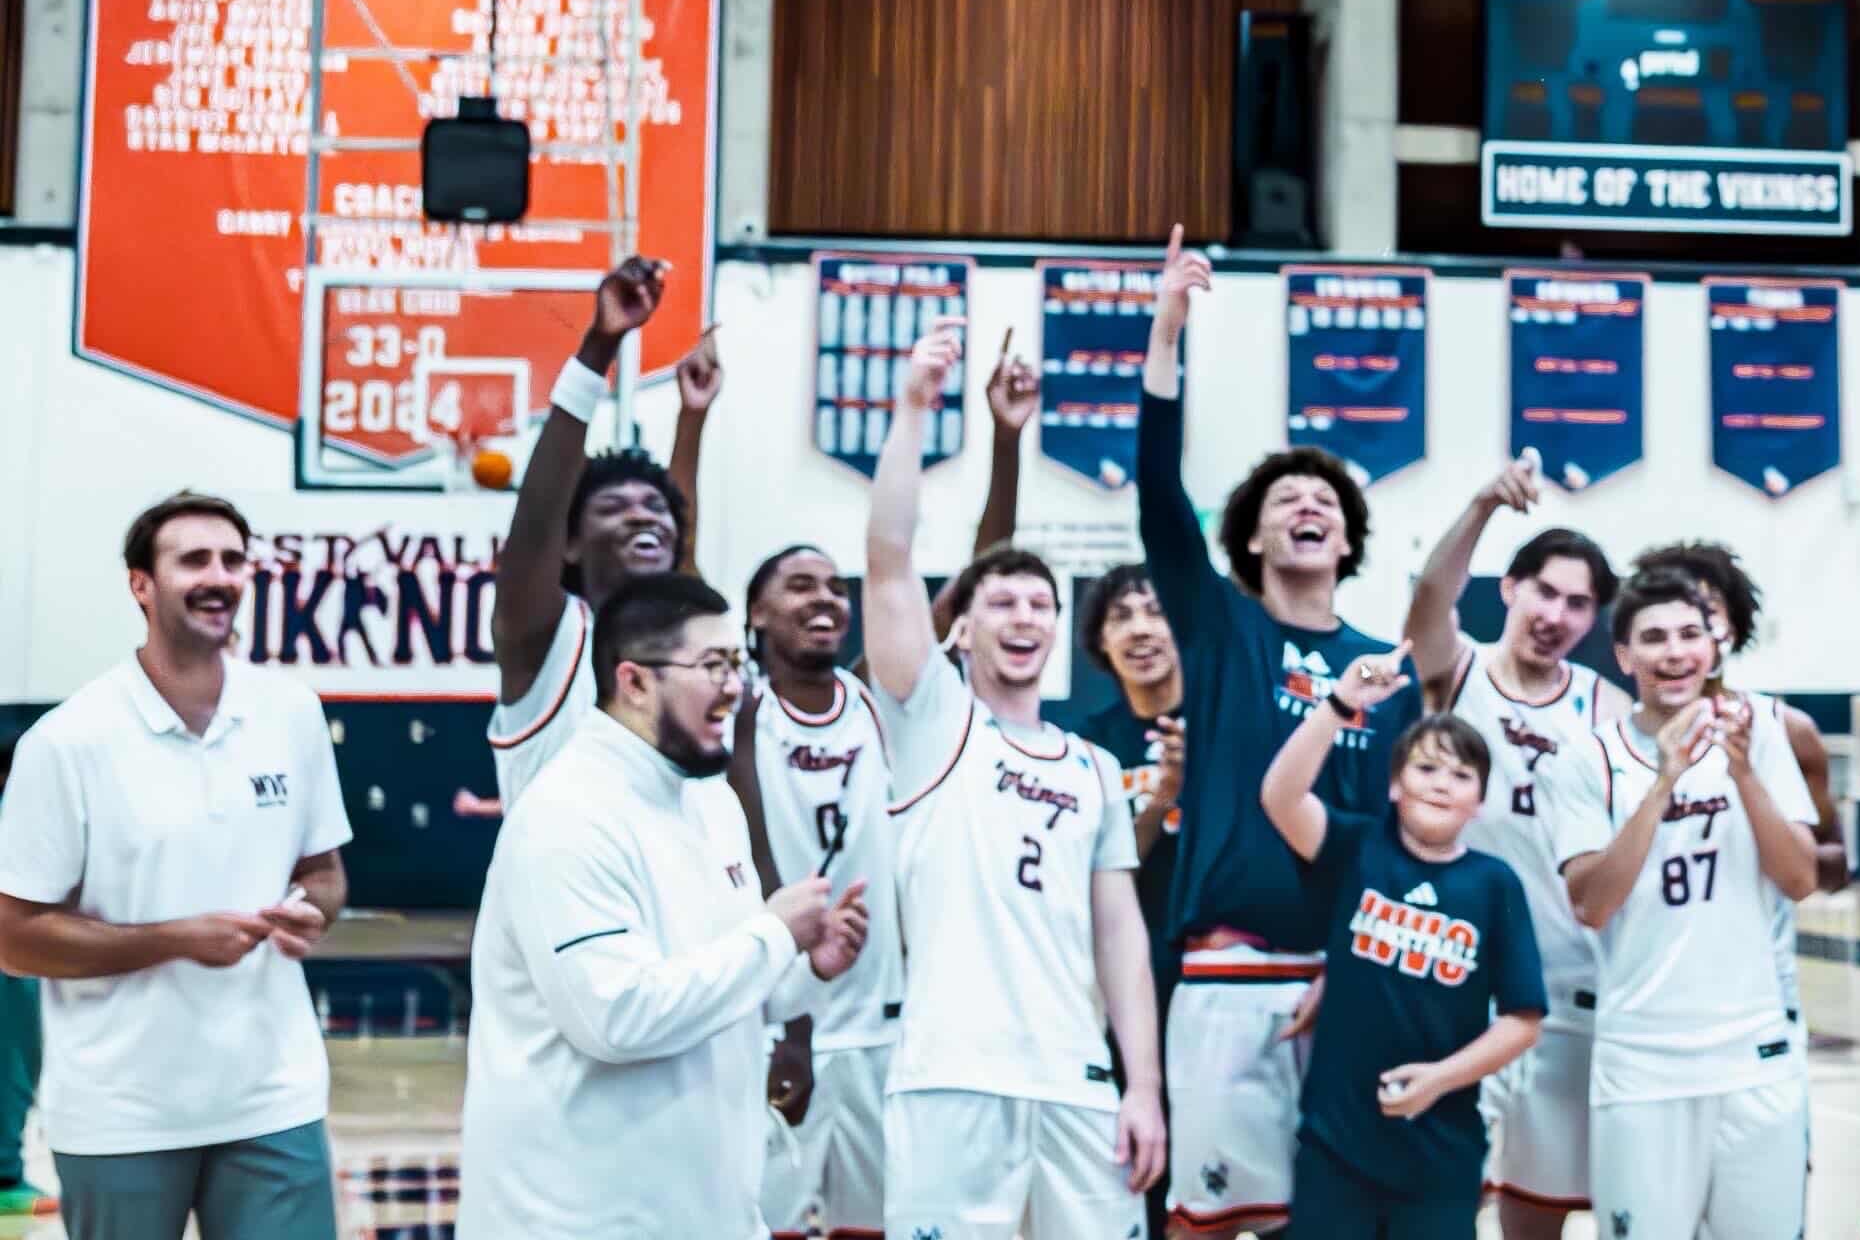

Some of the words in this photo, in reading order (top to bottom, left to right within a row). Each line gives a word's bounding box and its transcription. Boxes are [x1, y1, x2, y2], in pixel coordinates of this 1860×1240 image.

[1497, 164, 1588, 206] HOME
[1594, 167, 1638, 207] OF
[1645, 169, 1712, 209] THE
[345, 324, 446, 377] 33-0
[1661, 792, 1730, 840] ikings
[1018, 835, 1043, 892] 2
[1662, 850, 1718, 907] 87
